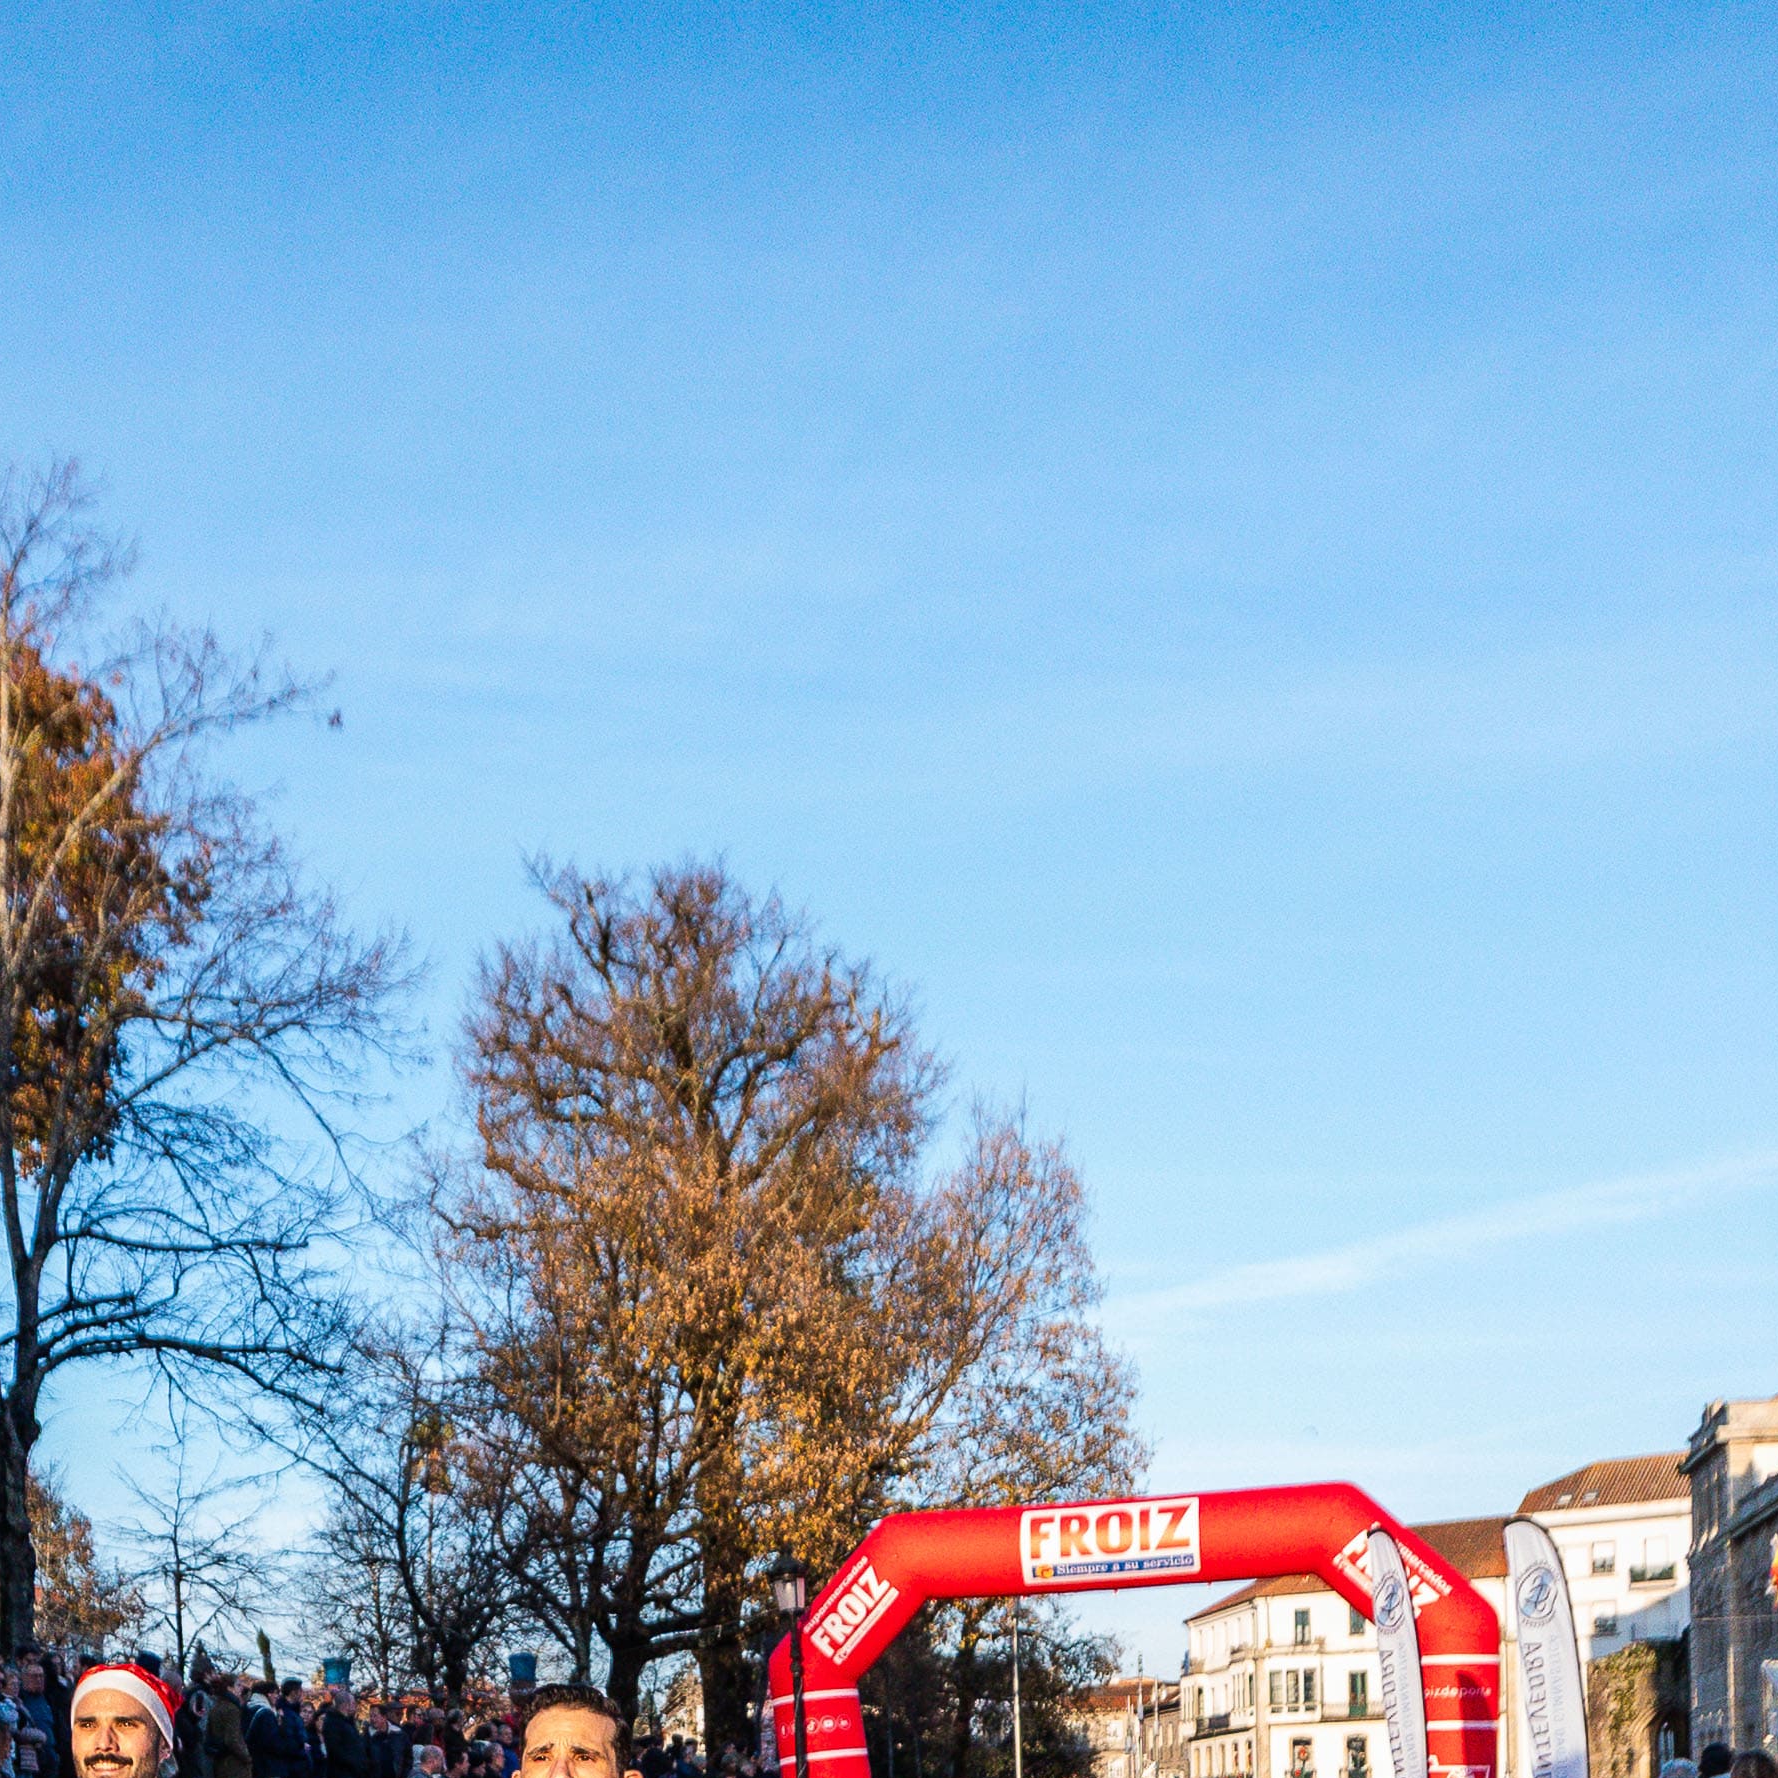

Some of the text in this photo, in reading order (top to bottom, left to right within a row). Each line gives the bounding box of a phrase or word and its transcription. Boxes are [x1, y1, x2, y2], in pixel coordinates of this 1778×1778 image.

[1029, 1504, 1192, 1560] FROIZ
[1057, 1563, 1108, 1576] Siempre
[1125, 1560, 1140, 1570] su
[1143, 1554, 1194, 1568] servicio
[803, 1555, 869, 1635] supermercados
[810, 1564, 891, 1660] FROIZ
[1424, 1683, 1492, 1698] oizdeporte
